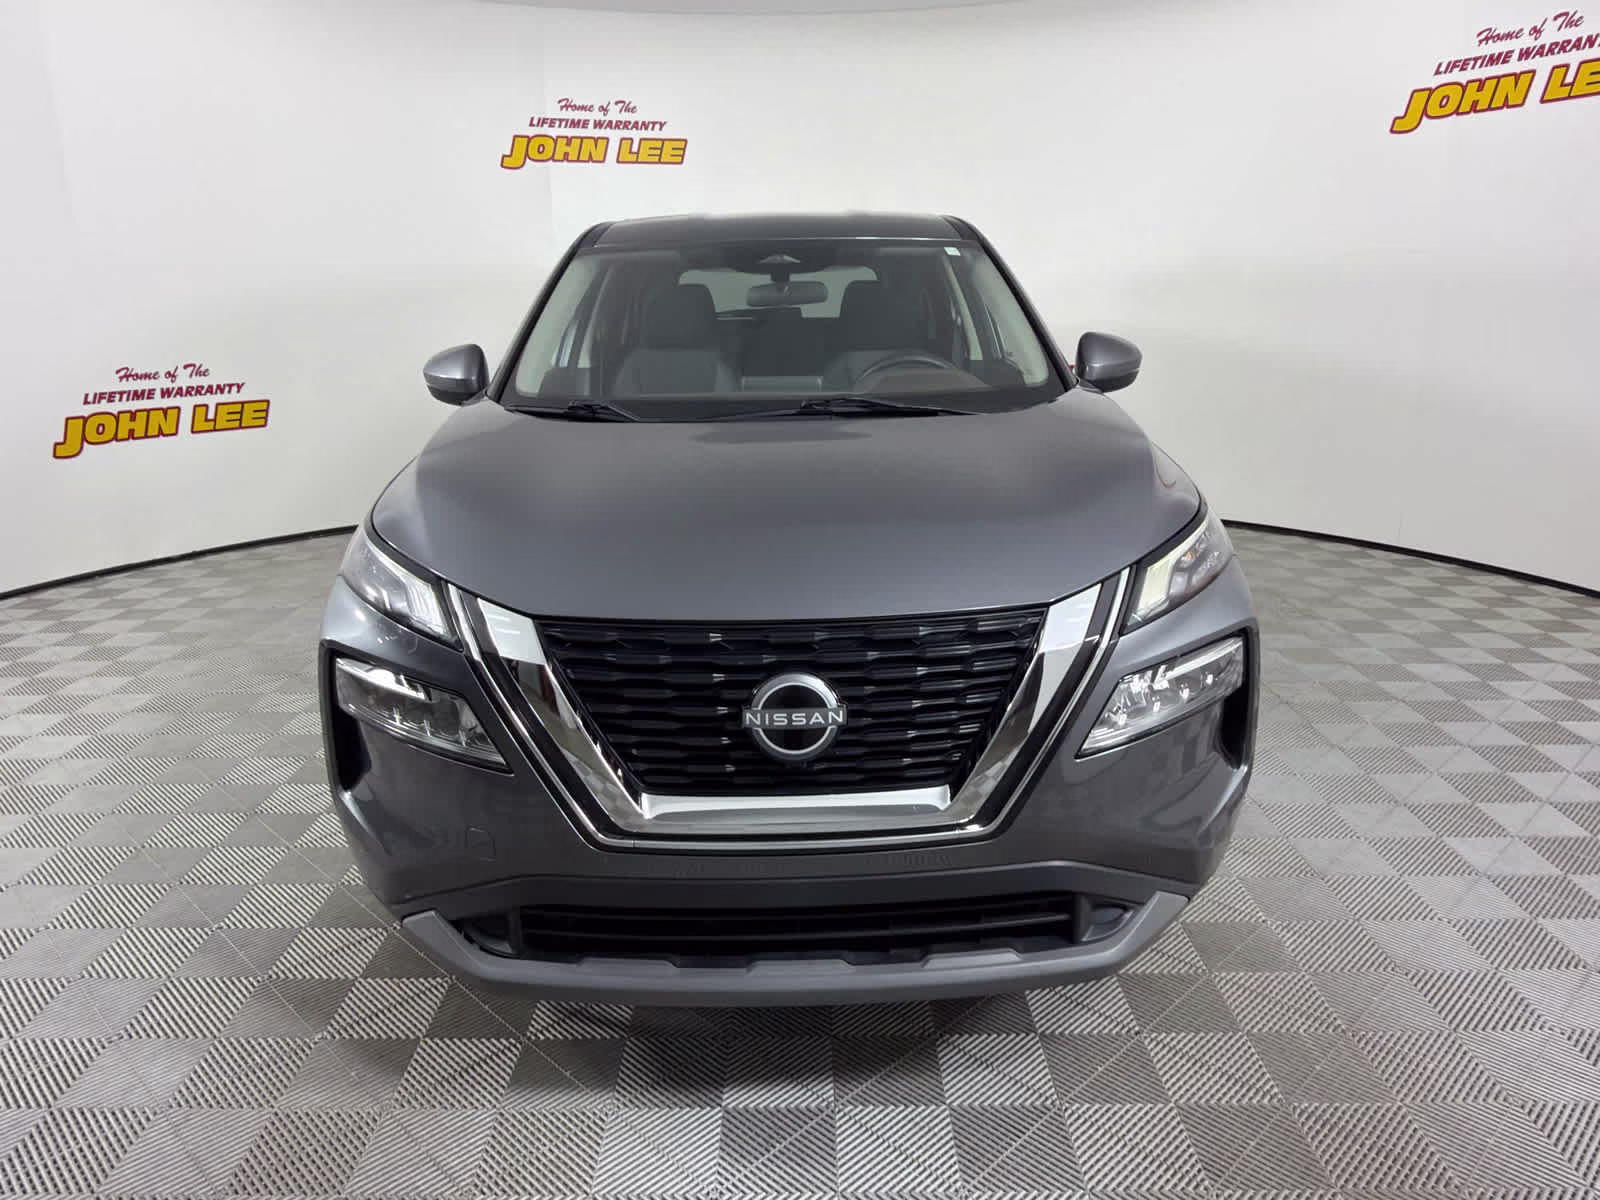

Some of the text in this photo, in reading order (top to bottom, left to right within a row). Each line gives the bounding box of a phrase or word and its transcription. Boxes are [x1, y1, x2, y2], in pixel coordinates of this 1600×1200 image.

[1476, 10, 1584, 46] Home of The
[1434, 33, 1600, 76] LIFETIME WARRAN
[557, 98, 637, 116] Home of The
[1390, 69, 1536, 134] JOHN
[529, 117, 667, 131] LIFETIME WARRANTY
[500, 134, 688, 169] JOHN LEE
[115, 363, 210, 382] Home of The
[83, 382, 245, 405] LIFETIME WARRANTY
[53, 399, 270, 458] JOHN LEE
[745, 710, 843, 725] NISSAN
